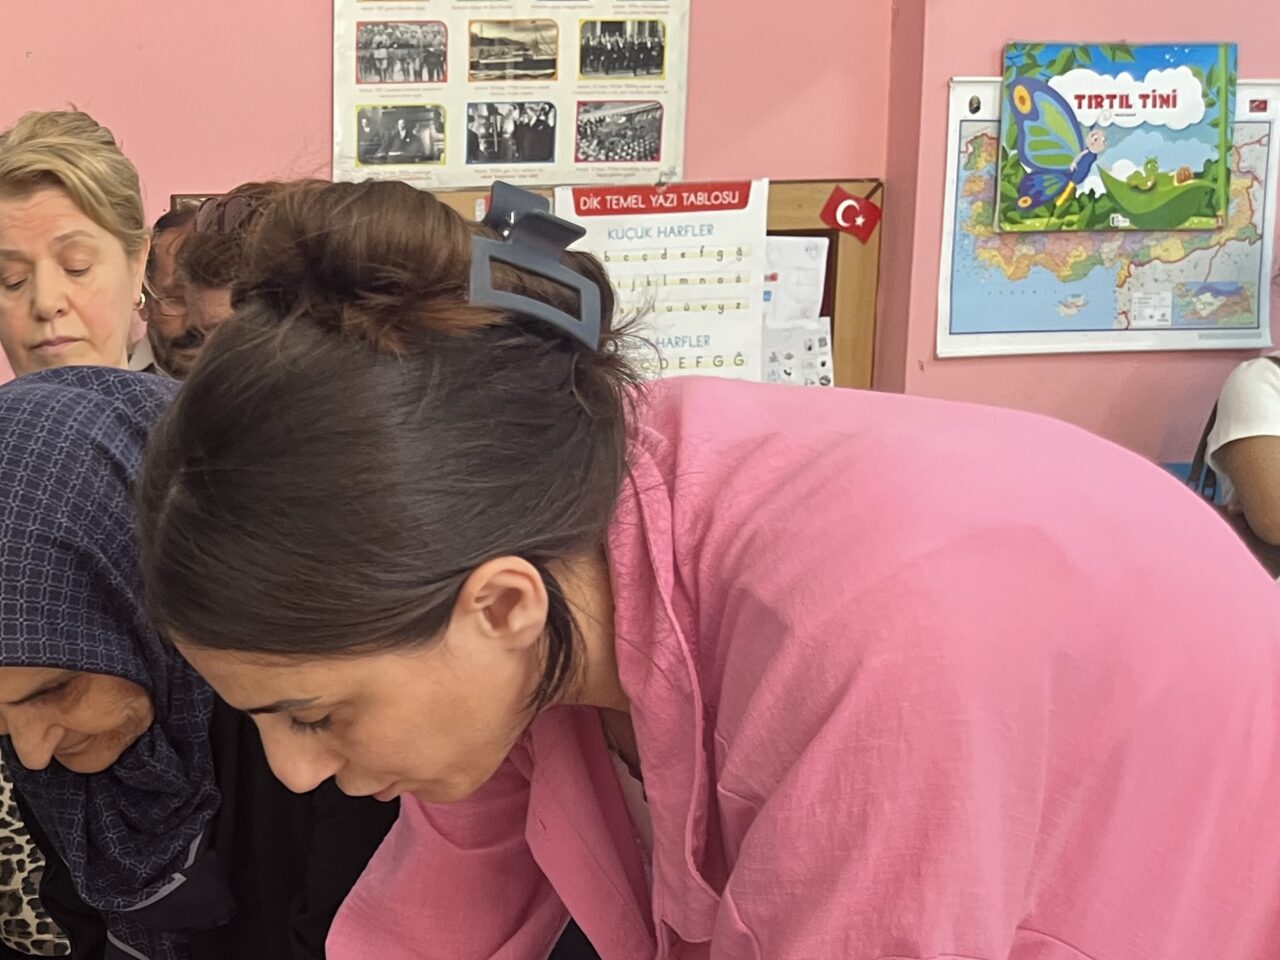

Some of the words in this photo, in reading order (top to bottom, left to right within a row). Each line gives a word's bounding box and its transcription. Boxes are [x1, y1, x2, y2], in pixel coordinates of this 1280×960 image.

[1074, 93, 1132, 110] TIRTIL
[1138, 88, 1177, 109] TİNİ
[580, 193, 601, 210] DİK
[605, 195, 646, 209] TEMEL
[649, 194, 677, 208] YAZI
[682, 191, 739, 206] TABLOSU
[657, 224, 714, 237] HARFLER
[656, 335, 711, 350] HARFLER
[679, 356, 686, 369] E
[696, 355, 703, 368] F
[713, 354, 724, 367] G
